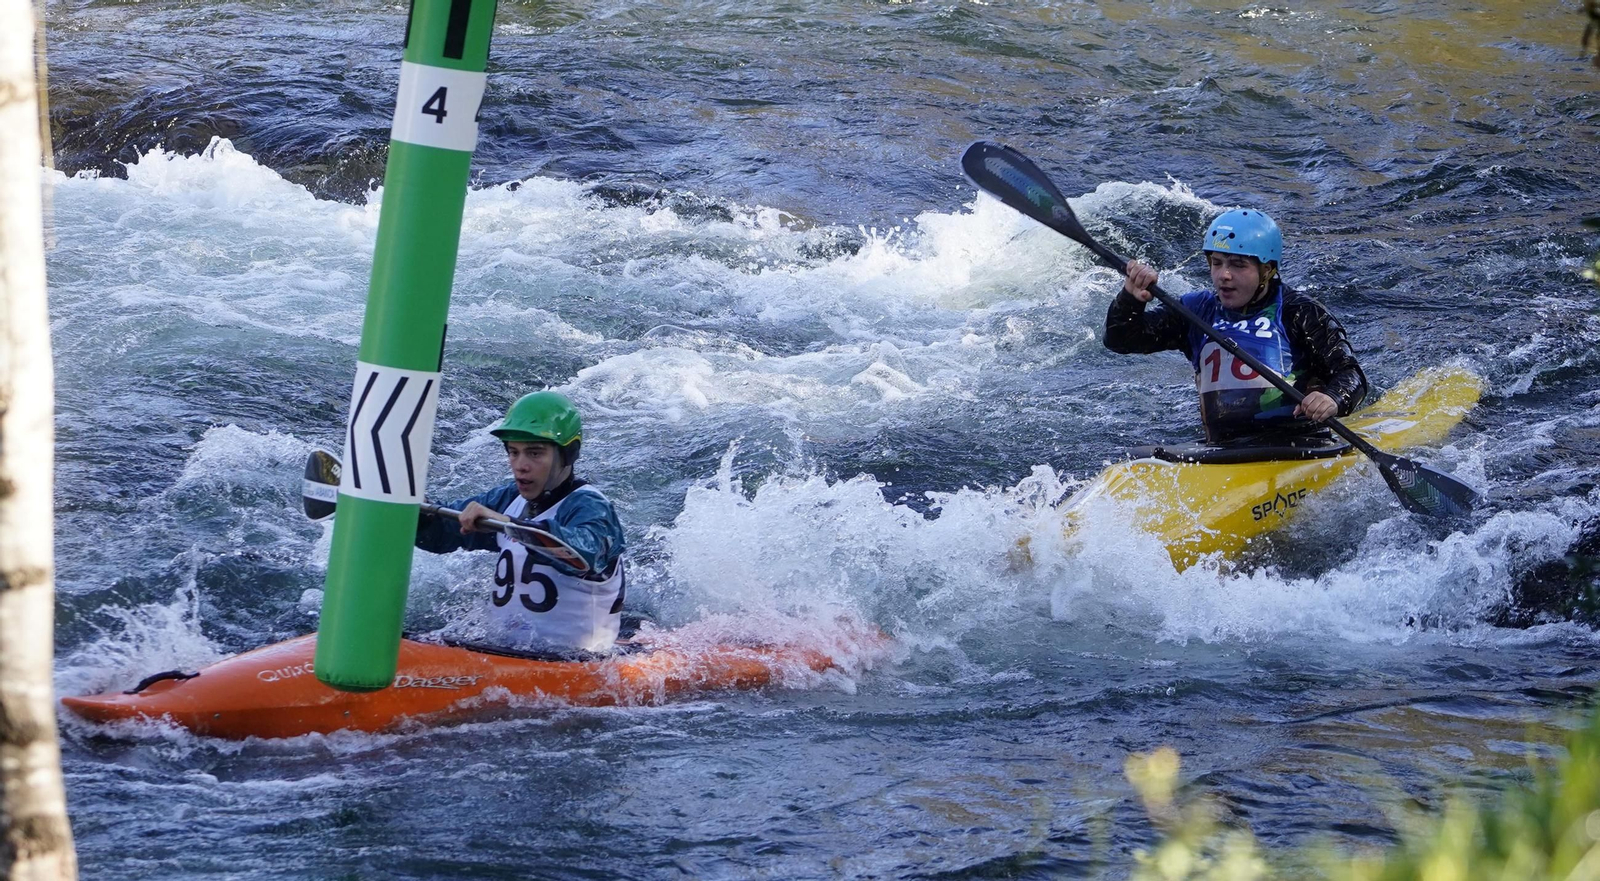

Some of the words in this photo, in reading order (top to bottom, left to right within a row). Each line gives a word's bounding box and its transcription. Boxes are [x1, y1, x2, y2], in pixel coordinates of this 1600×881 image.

[421, 86, 448, 124] 4
[492, 548, 559, 613] 95
[393, 674, 484, 690] Dagger
